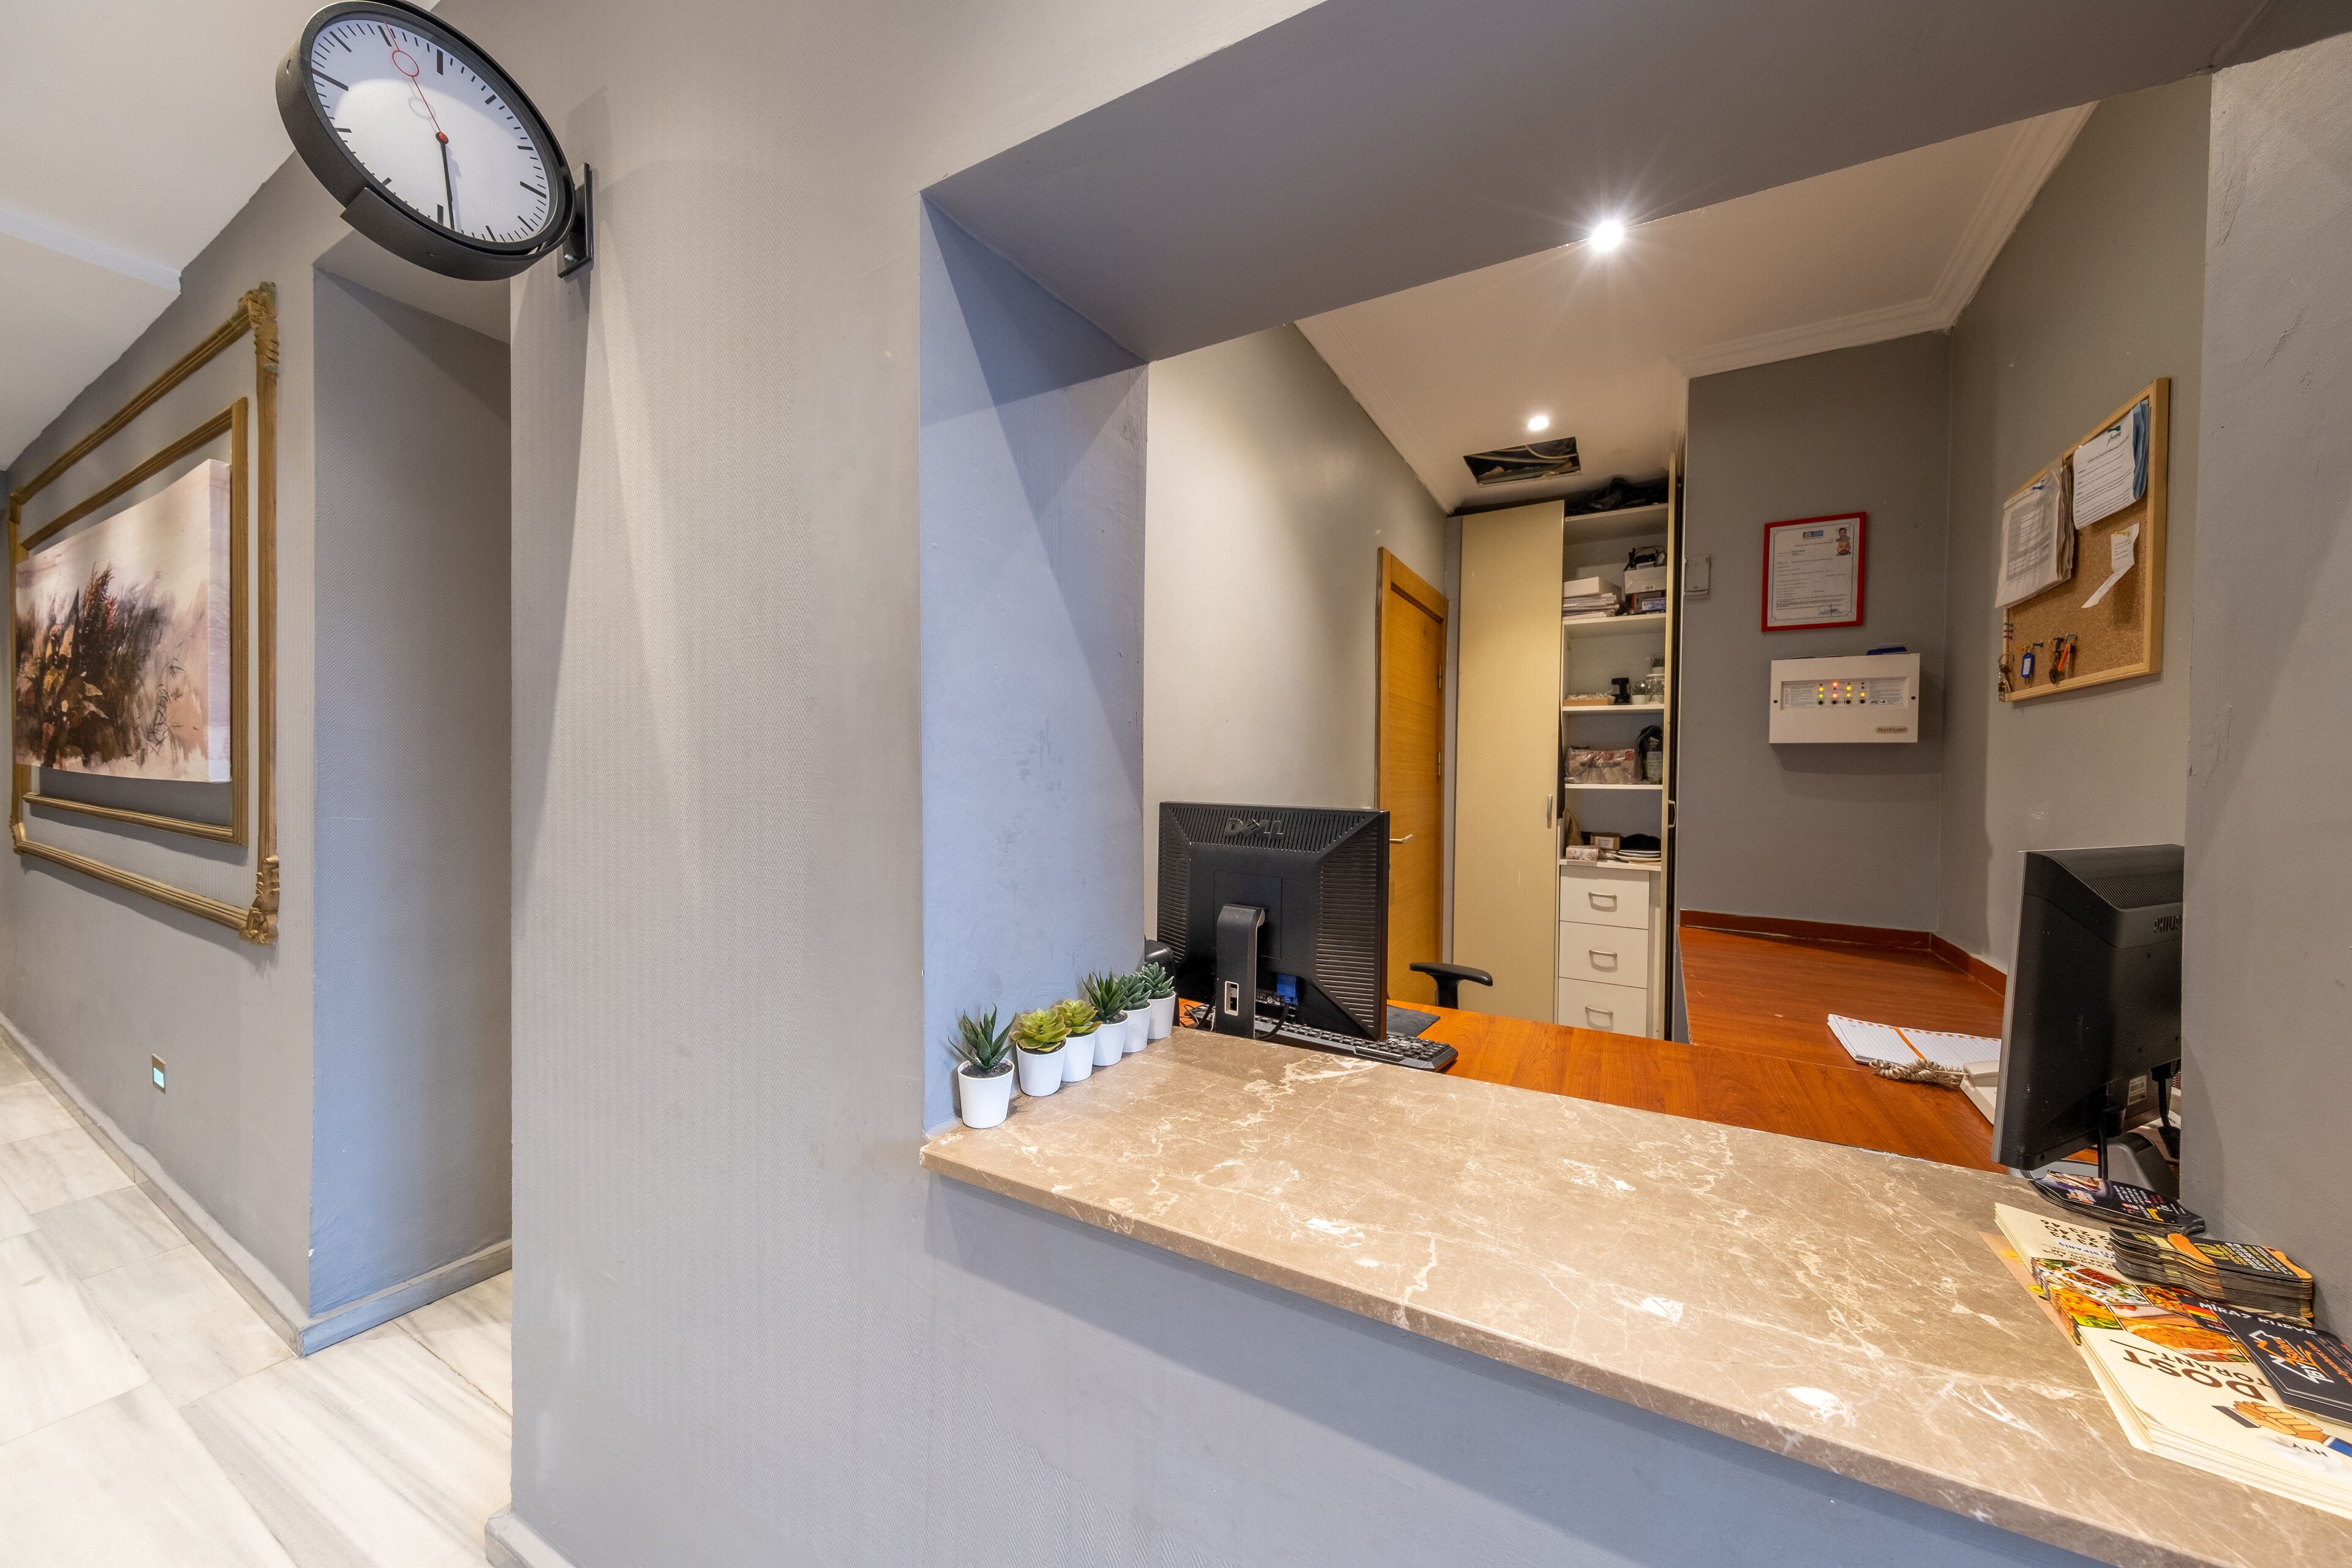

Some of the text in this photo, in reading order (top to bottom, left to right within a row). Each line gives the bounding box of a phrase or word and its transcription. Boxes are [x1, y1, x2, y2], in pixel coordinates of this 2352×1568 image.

[1224, 818, 1283, 839] DELL
[2040, 1219, 2061, 1228] 46
[2044, 1225, 2098, 1243] 23 40
[2050, 1231, 2071, 1241] 93
[2068, 1227, 2092, 1237] 23
[2076, 1237, 2099, 1248] 93
[2122, 1349, 2268, 1402] DOST
[2161, 1352, 2272, 1388] TORANT
